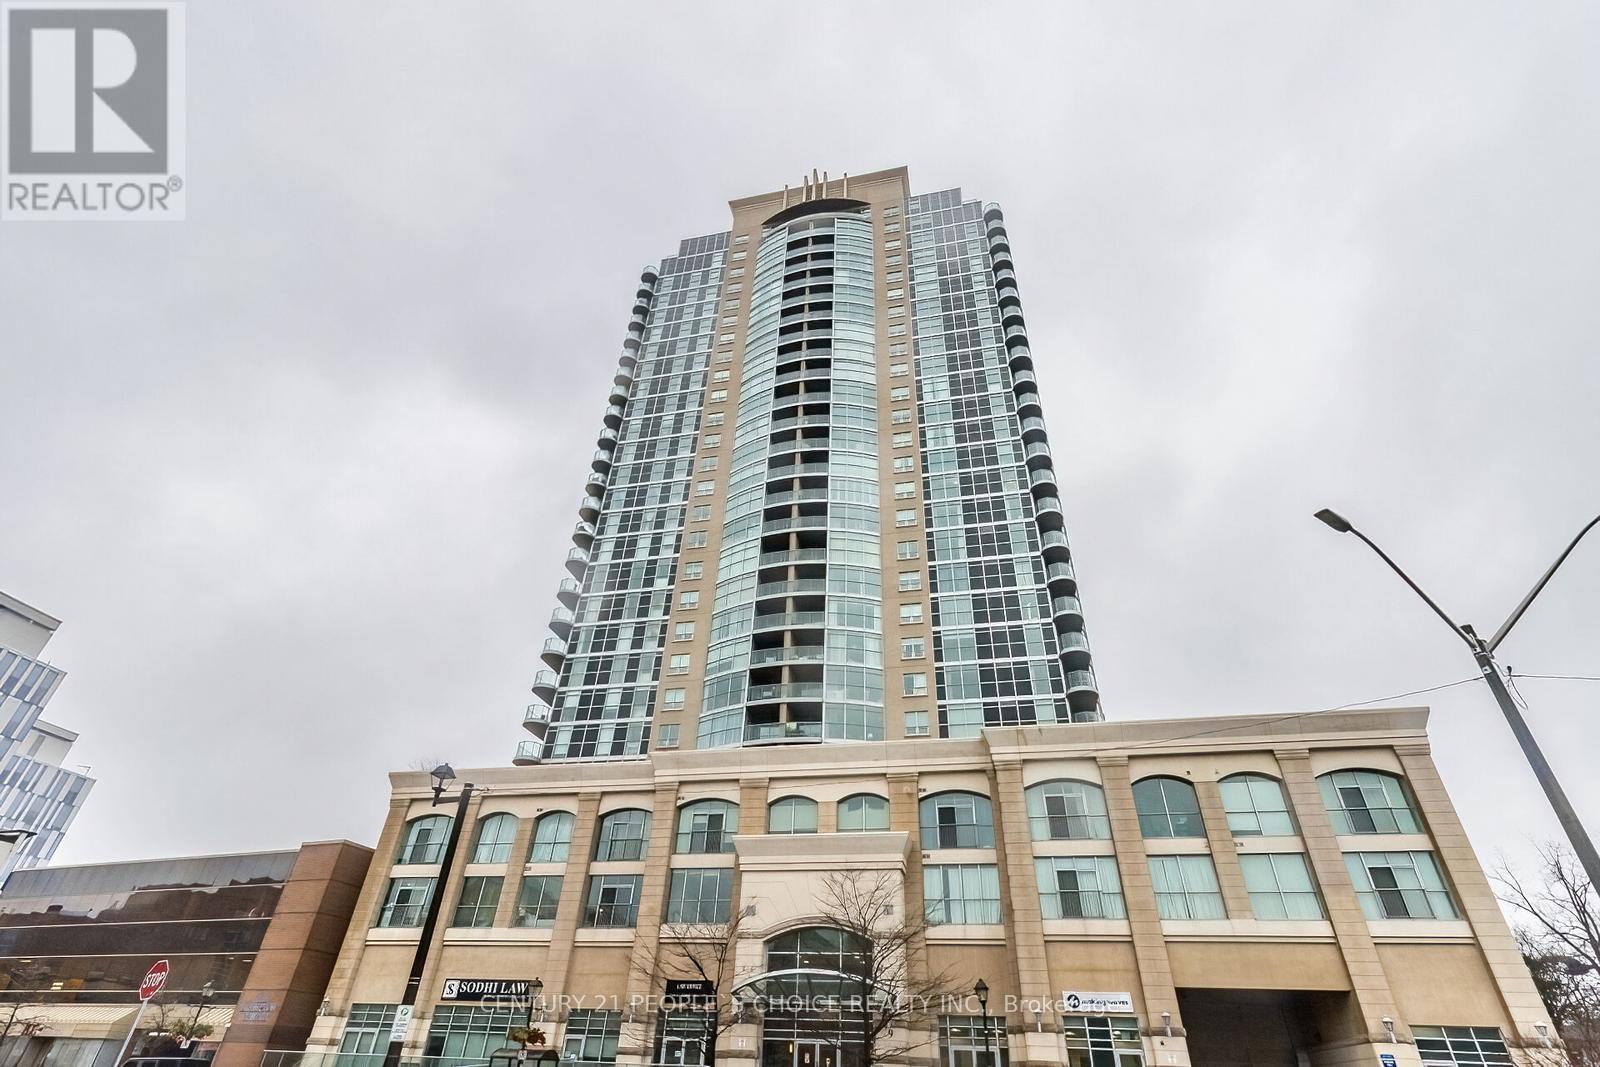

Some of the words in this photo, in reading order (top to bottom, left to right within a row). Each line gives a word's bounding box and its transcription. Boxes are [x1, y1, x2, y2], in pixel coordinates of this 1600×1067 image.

[142, 971, 166, 989] STOP
[459, 981, 499, 994] SODHI
[500, 982, 529, 995] LAW
